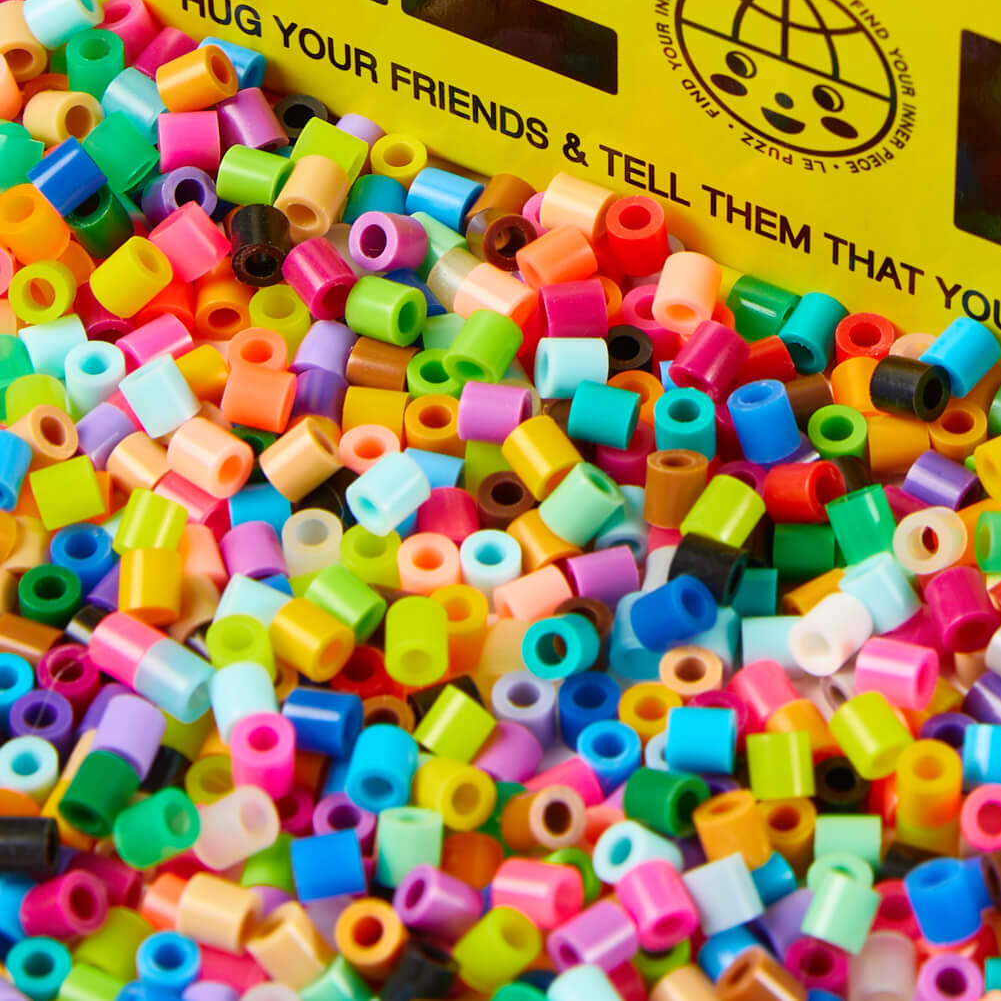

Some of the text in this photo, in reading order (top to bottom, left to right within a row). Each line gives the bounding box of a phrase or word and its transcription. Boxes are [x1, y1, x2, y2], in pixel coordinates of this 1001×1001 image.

[656, 22, 682, 71] YOUR
[681, 78, 720, 119] FIND
[848, 0, 917, 174] FIND YOUR INNER PIECE
[272, 14, 379, 84] YOUR
[390, 62, 549, 150] FRIENDS
[562, 132, 590, 167] &
[599, 143, 691, 207] TELL
[701, 184, 811, 253] THEM
[823, 232, 924, 295] THAT
[740, 132, 827, 174] LE PUZZ
